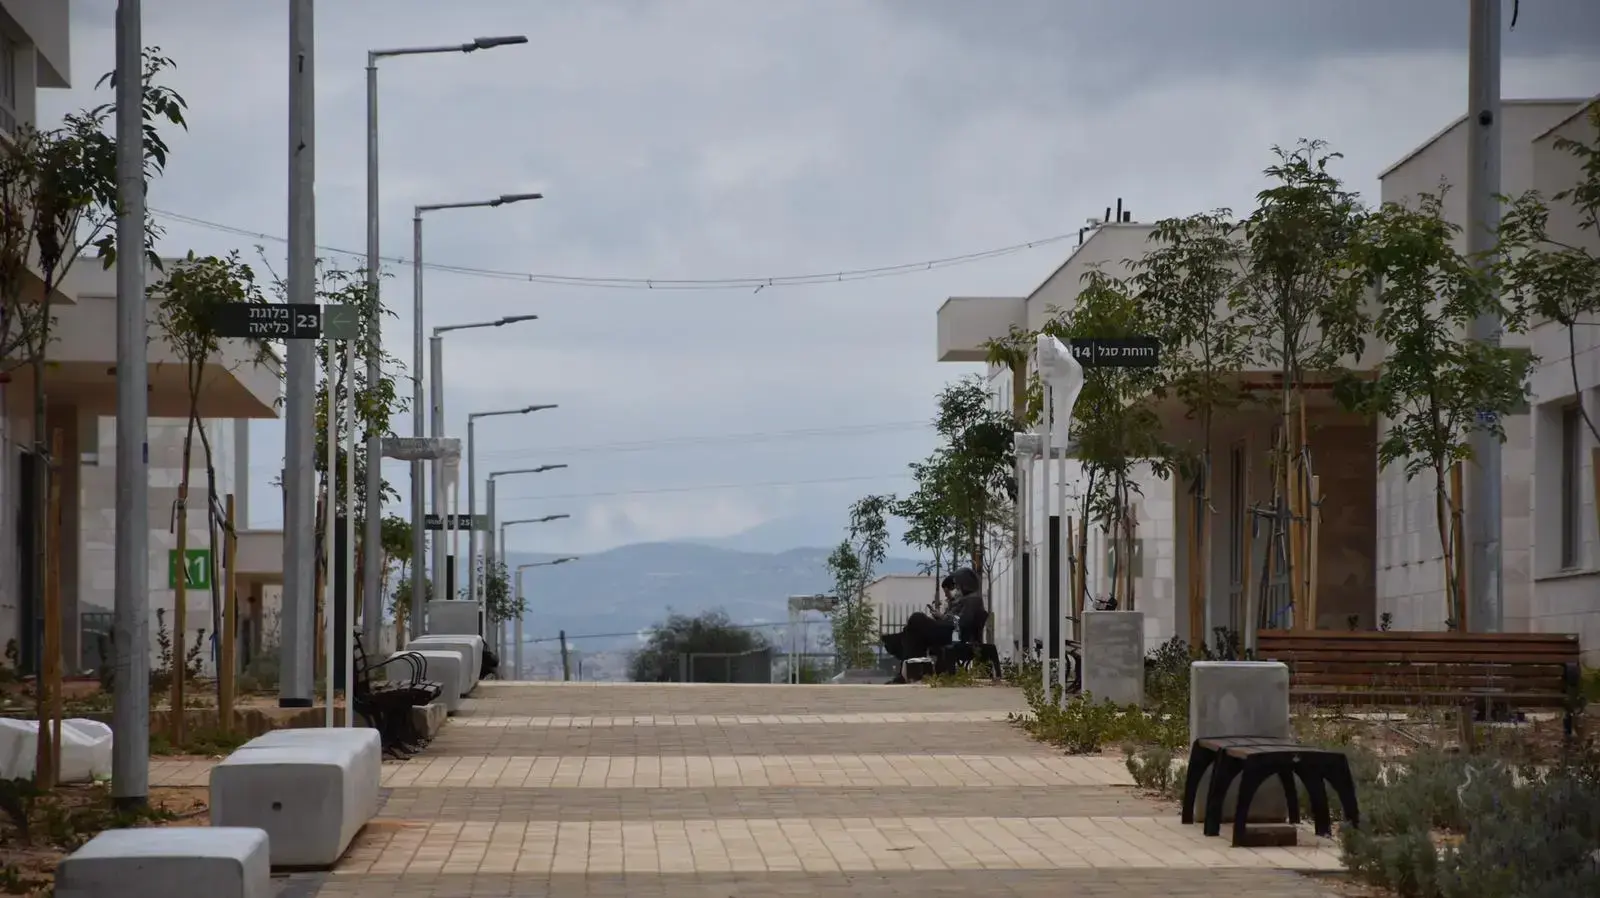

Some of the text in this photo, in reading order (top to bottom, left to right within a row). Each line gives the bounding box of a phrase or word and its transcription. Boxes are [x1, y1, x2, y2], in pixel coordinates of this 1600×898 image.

[248, 306, 289, 319] פלוגת
[249, 320, 289, 333] כליאה
[297, 314, 318, 328] 23
[1073, 346, 1092, 358] 14
[1098, 345, 1154, 357] רווחת סגל
